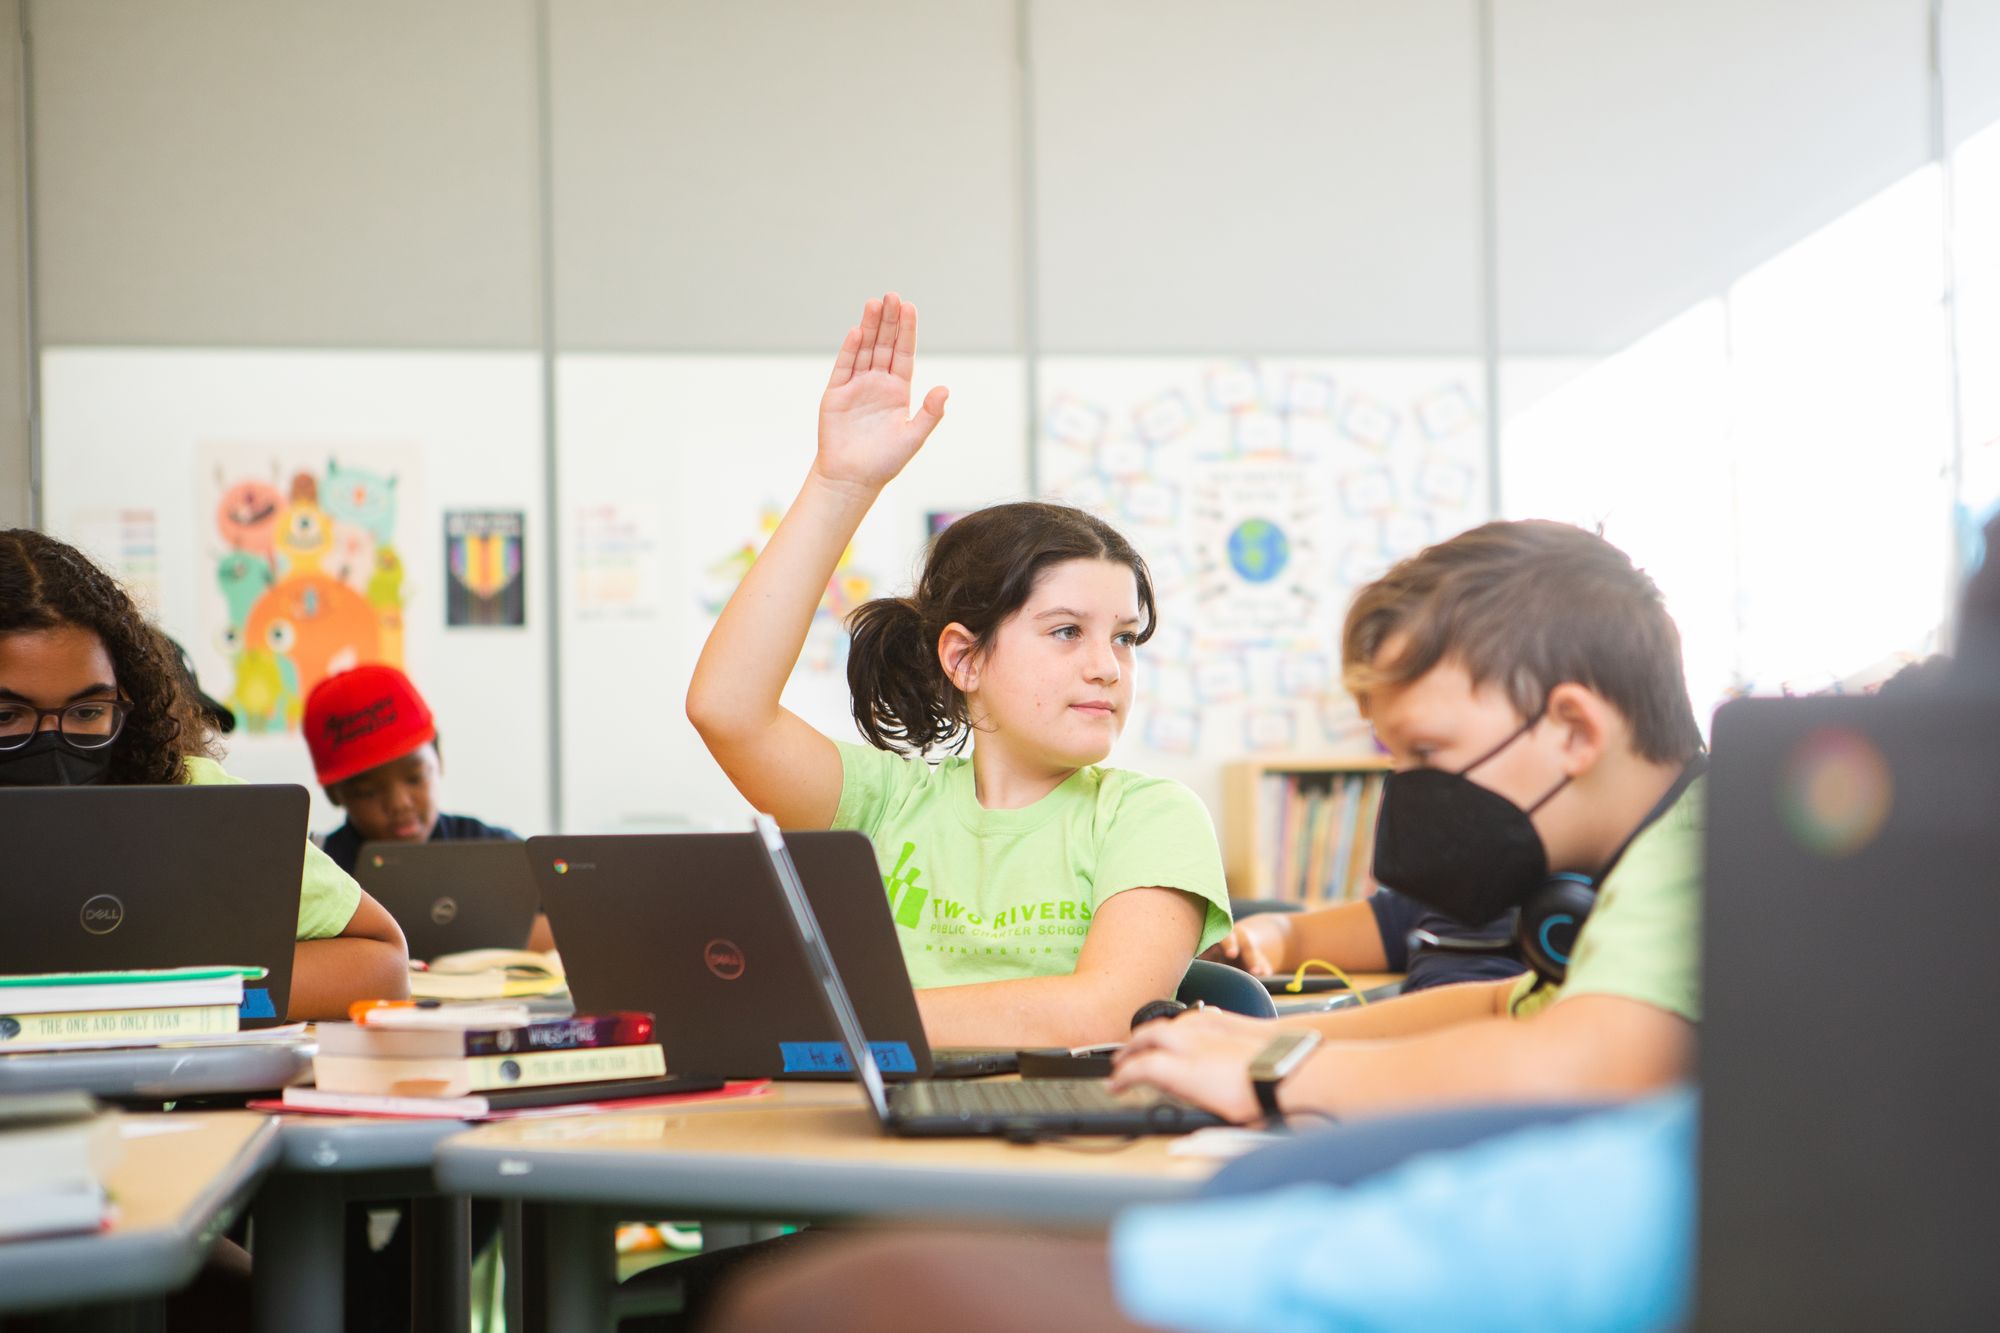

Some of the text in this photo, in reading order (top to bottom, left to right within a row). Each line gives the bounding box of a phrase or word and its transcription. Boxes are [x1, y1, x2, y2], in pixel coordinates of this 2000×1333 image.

[932, 899, 1092, 930] TWO RIVERS
[39, 1018, 63, 1036] THE
[66, 1017, 89, 1034] ONE
[93, 1015, 116, 1033] AND
[120, 1014, 148, 1032] ONLY
[153, 1012, 180, 1030] IVAN
